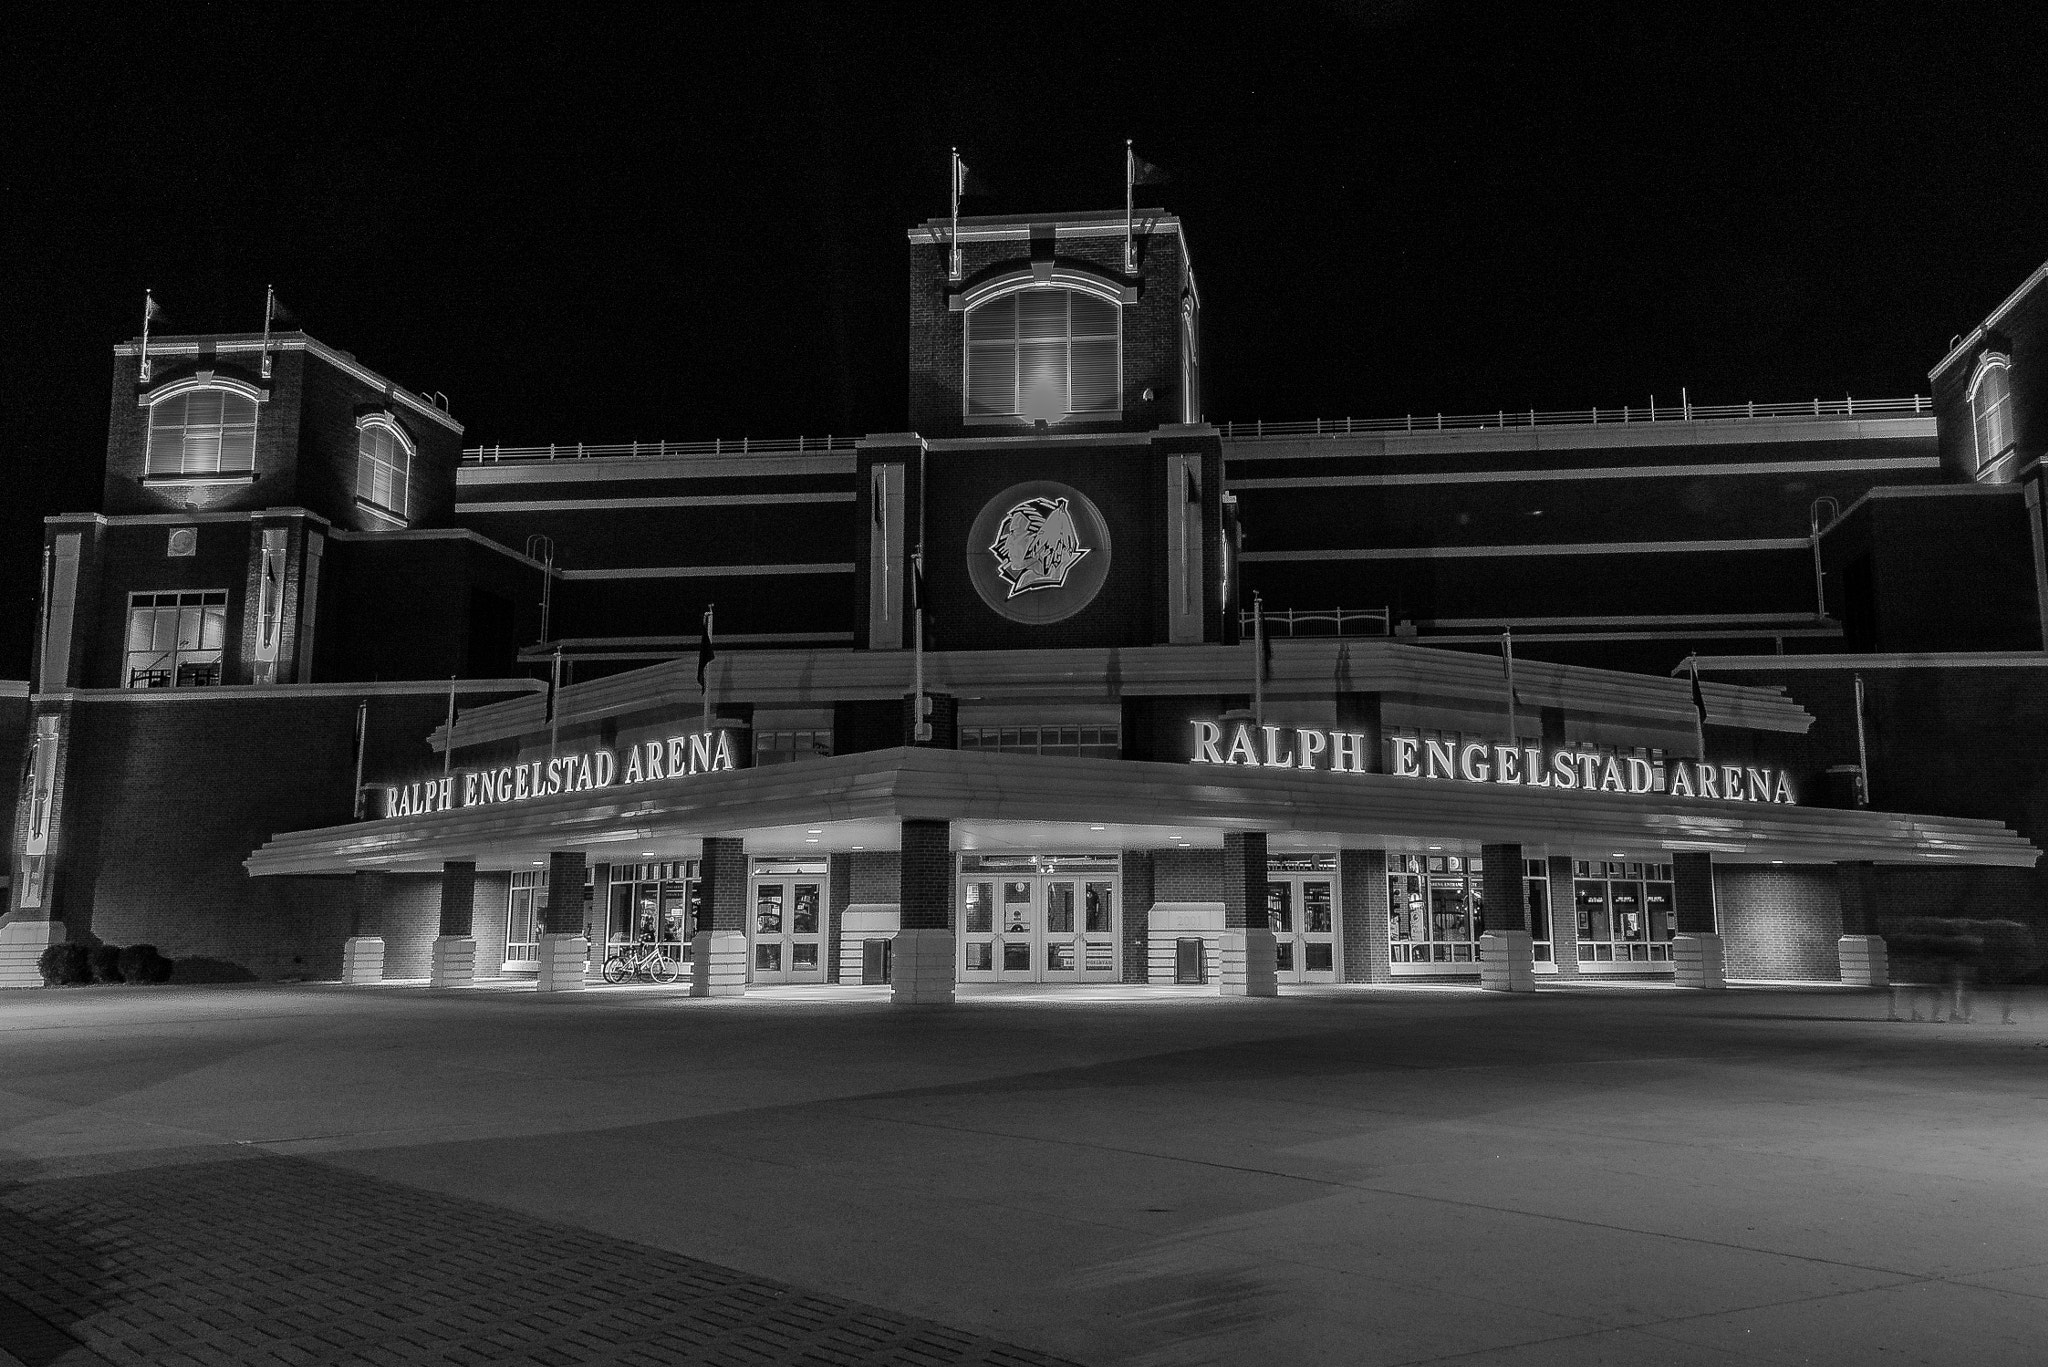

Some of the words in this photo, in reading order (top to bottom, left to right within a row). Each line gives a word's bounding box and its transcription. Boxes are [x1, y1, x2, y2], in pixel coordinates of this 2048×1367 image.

[385, 776, 454, 819] RALPH
[463, 750, 614, 808] ENGELSTAD
[624, 730, 734, 784] ARENA
[1190, 719, 1366, 773] RALPH
[1392, 736, 1653, 794] ENGELSTAD
[1671, 761, 1796, 805] ARENA
[1177, 915, 1201, 927] 2001
